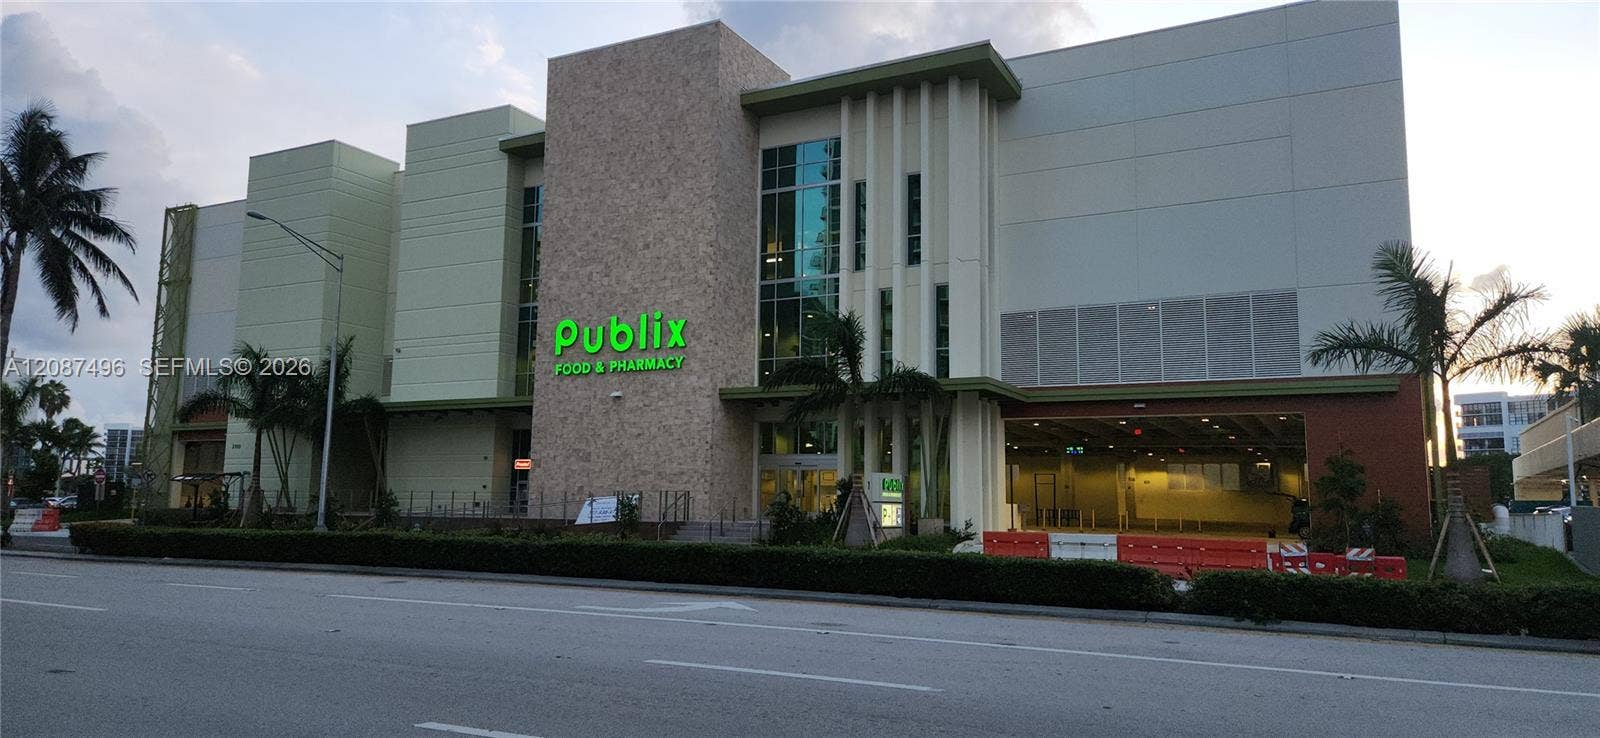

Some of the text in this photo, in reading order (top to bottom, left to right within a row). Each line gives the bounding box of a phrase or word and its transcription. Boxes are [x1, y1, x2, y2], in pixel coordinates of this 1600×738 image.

[555, 311, 687, 355] Publix
[555, 356, 685, 376] FOOD & PHARMACY
